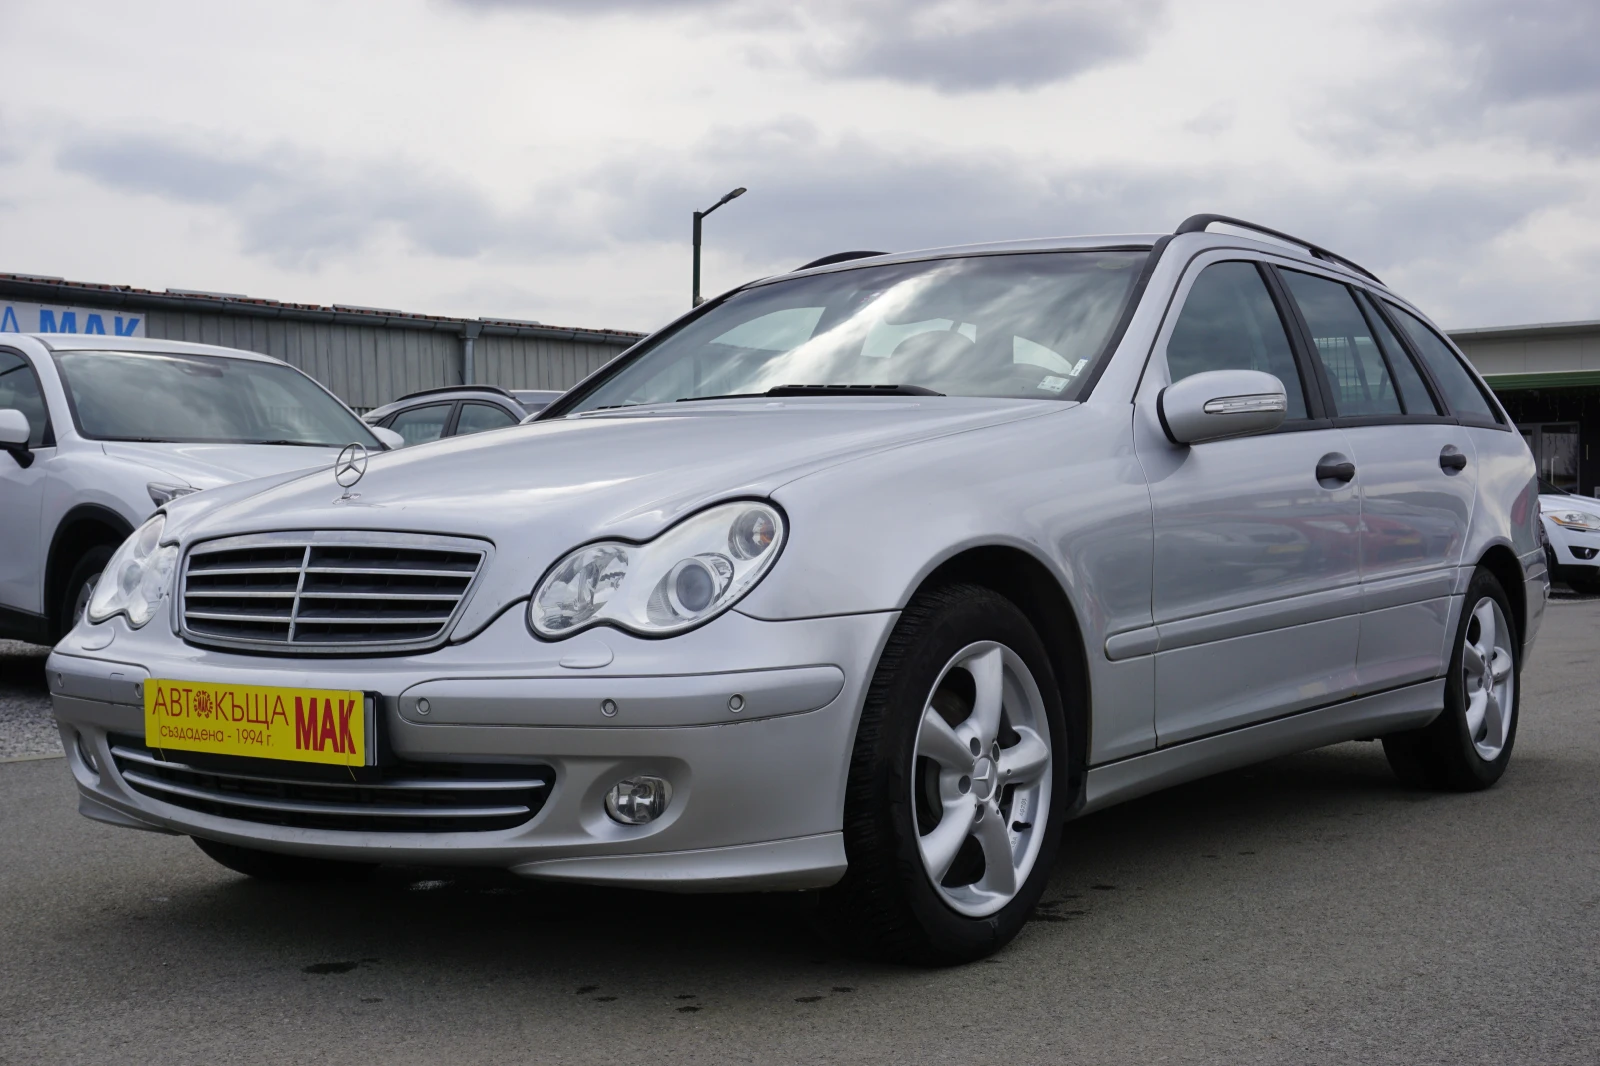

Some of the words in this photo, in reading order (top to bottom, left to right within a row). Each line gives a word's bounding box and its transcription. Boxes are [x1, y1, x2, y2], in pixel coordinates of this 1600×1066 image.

[160, 725, 224, 743] създадена
[236, 728, 264, 746] 1994
[295, 696, 356, 754] МАК
